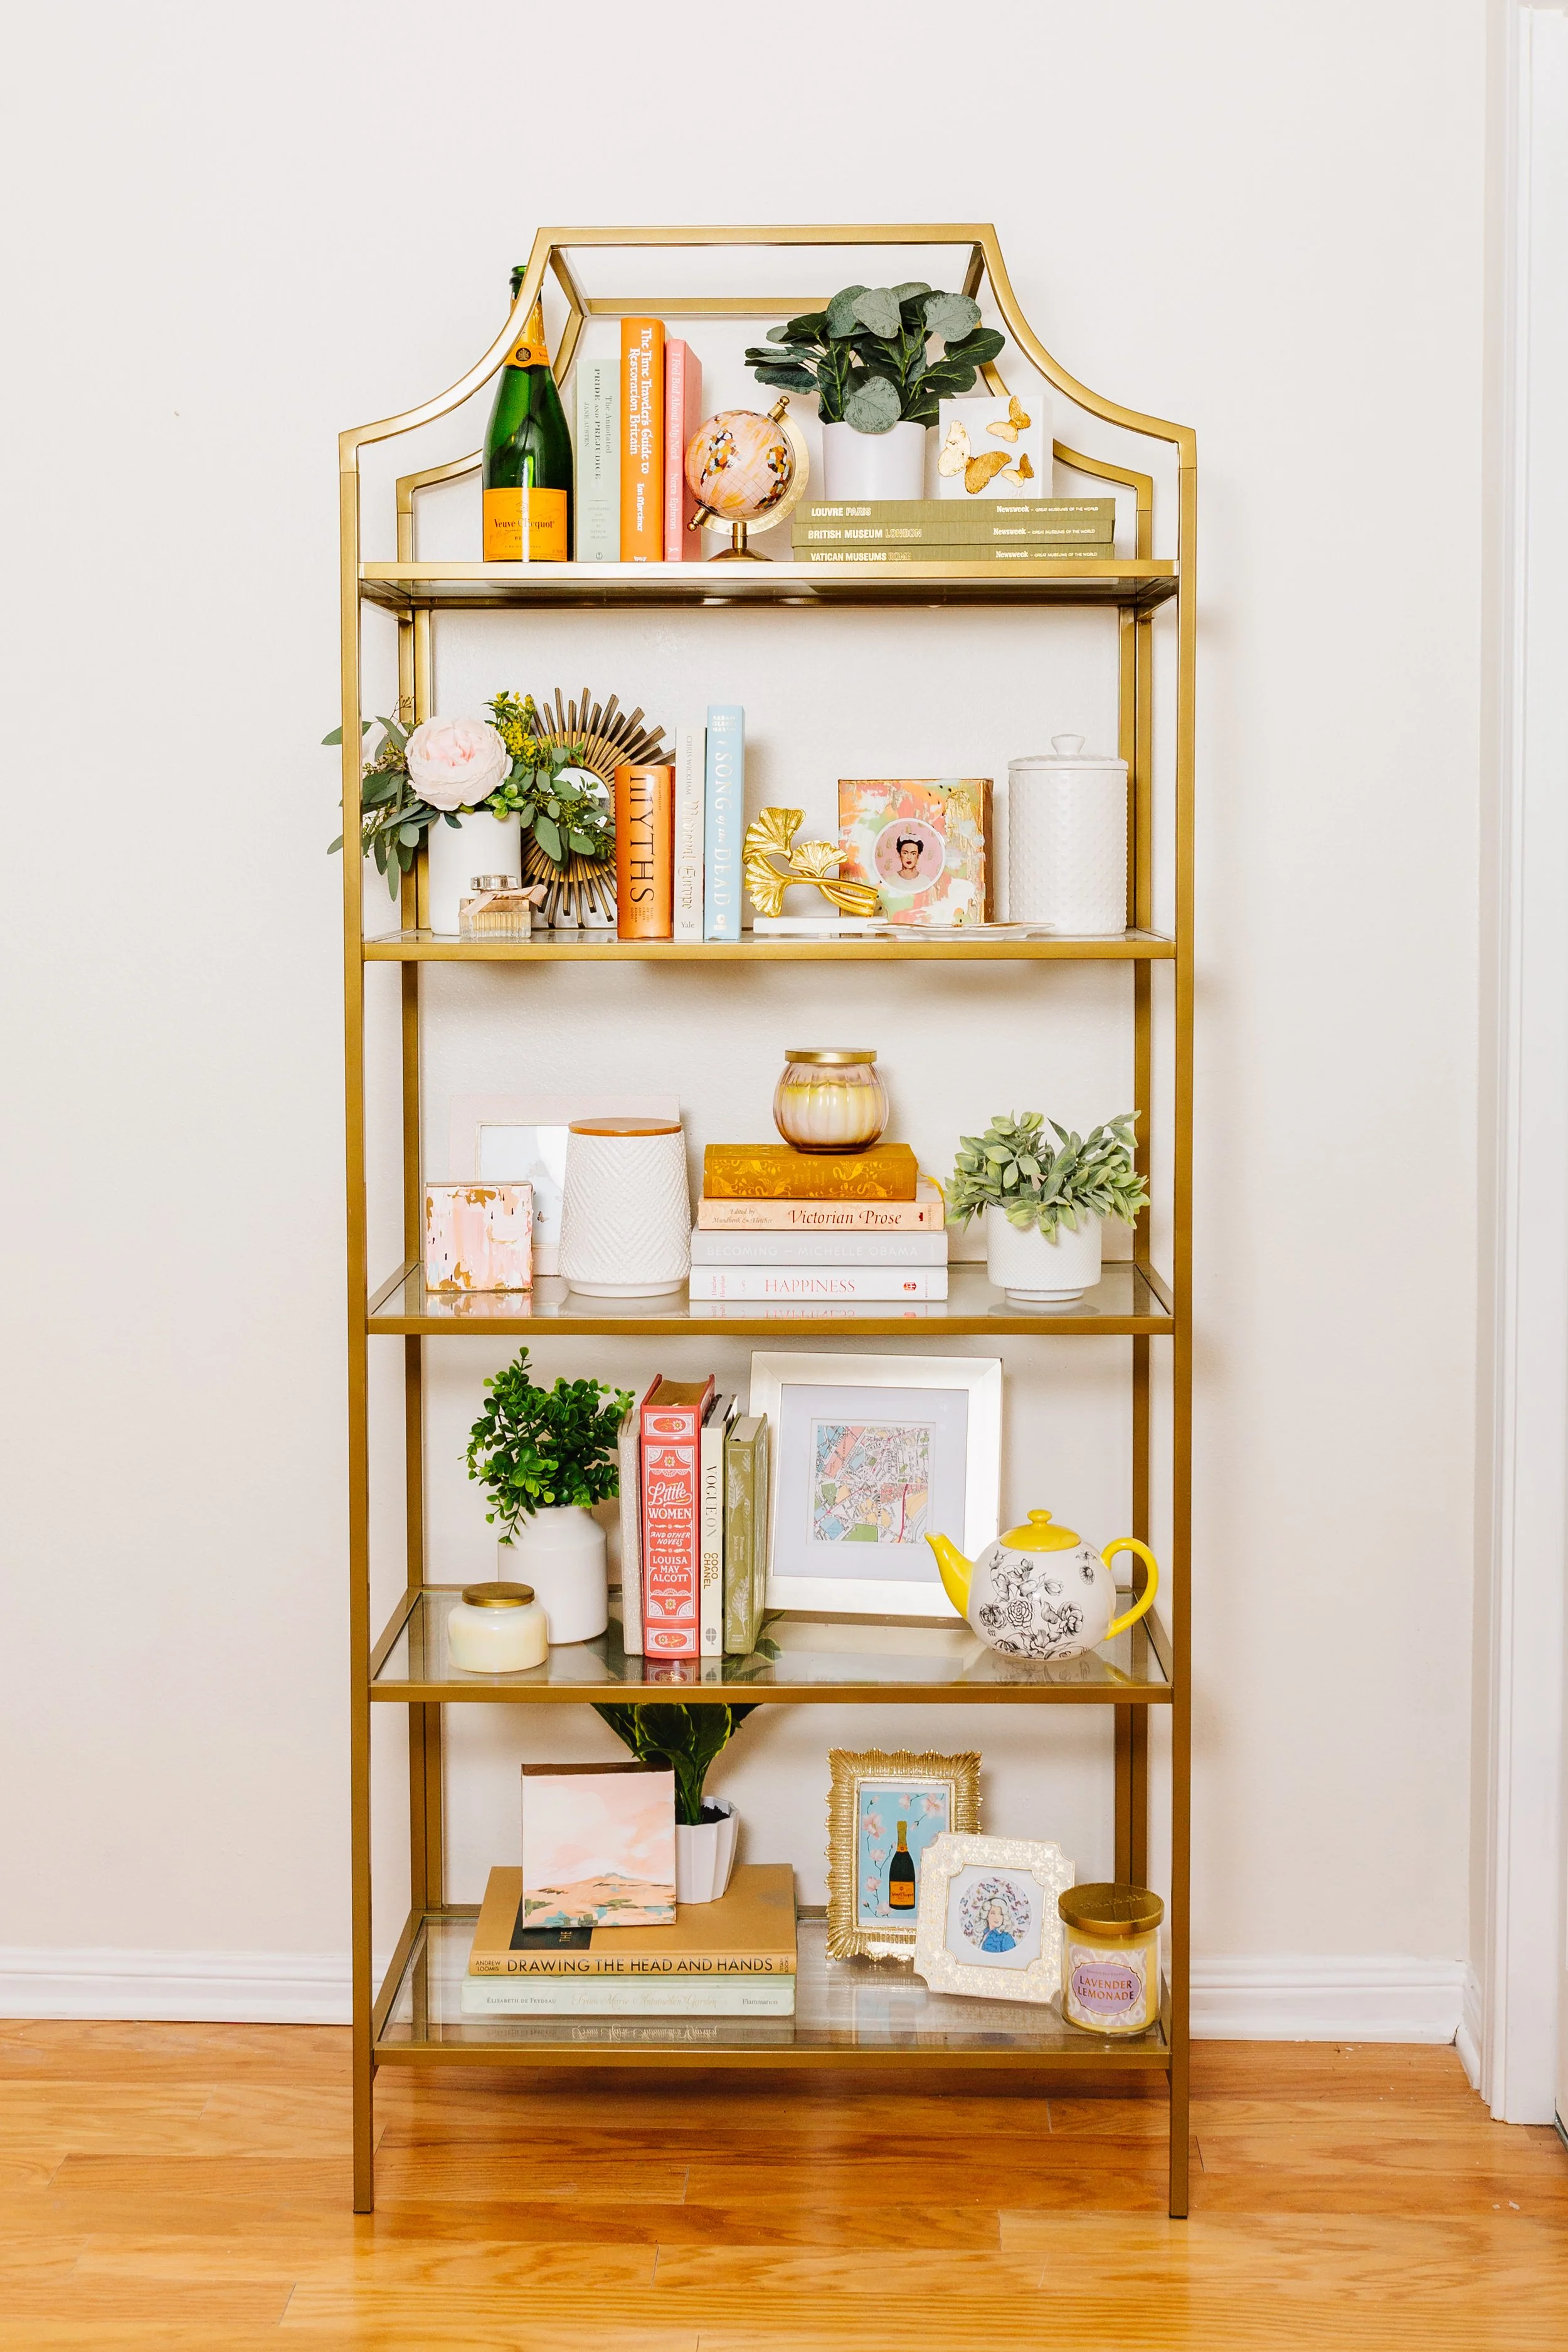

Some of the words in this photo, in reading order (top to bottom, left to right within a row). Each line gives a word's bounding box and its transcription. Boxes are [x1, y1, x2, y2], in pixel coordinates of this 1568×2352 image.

[641, 328, 652, 349] The
[641, 350, 652, 378] Time
[672, 359, 681, 376] Feel
[628, 347, 640, 411] Restoration
[671, 376, 680, 394] Bad
[641, 379, 652, 426] Traveler's
[670, 394, 680, 421] About
[630, 414, 640, 455] Britain
[669, 423, 679, 438] My
[641, 428, 653, 461] Guide
[670, 440, 679, 460] Neck
[641, 462, 649, 474] to
[670, 473, 679, 494] Nora
[637, 496, 645, 532] Mortimer
[669, 497, 679, 529] Ephron
[811, 507, 843, 517] LOUVRE
[845, 507, 872, 516] PARIS
[494, 519, 516, 528] Veuve
[518, 517, 553, 529] Clicquot
[808, 530, 841, 539] BRITISH
[844, 529, 882, 539] MUSEUM
[885, 529, 922, 538] LONDON
[810, 553, 844, 561] VATICAN
[845, 553, 886, 561] MUSEUMS
[888, 553, 911, 561] ROME
[715, 753, 732, 810] SONG
[715, 815, 725, 825] of
[682, 800, 699, 859] Medieval
[718, 829, 726, 842] the
[714, 847, 731, 905] DEAD
[678, 866, 697, 909] Europe
[788, 1210, 853, 1224] Victorian
[859, 1210, 901, 1224] Prose
[707, 1246, 778, 1256] BECOMING
[798, 1247, 863, 1256] MICHELLE
[869, 1247, 918, 1256] OBAMA
[766, 1279, 856, 1293] HAPPINESS
[648, 1481, 692, 1507] Little
[706, 1466, 717, 1515] VOGUE
[648, 1507, 692, 1519] WOMEN
[706, 1518, 717, 1537] ON
[657, 1539, 683, 1547] NOVELS
[653, 1556, 687, 1564] LOUISA
[653, 1574, 688, 1582] ALCOTT
[559, 1931, 572, 1942] THE
[507, 1959, 590, 1972] DRAWING
[595, 1959, 624, 1971] THE
[631, 1959, 672, 1971] HEAD
[677, 1959, 712, 1971] AND
[718, 1958, 772, 1971] HANDS
[1079, 1975, 1132, 1989] LAVENDER
[1078, 1986, 1134, 2000] LEMONADE
[571, 1993, 598, 2007] From
[600, 1993, 628, 2011] Marie
[683, 1993, 719, 2010] Garden
